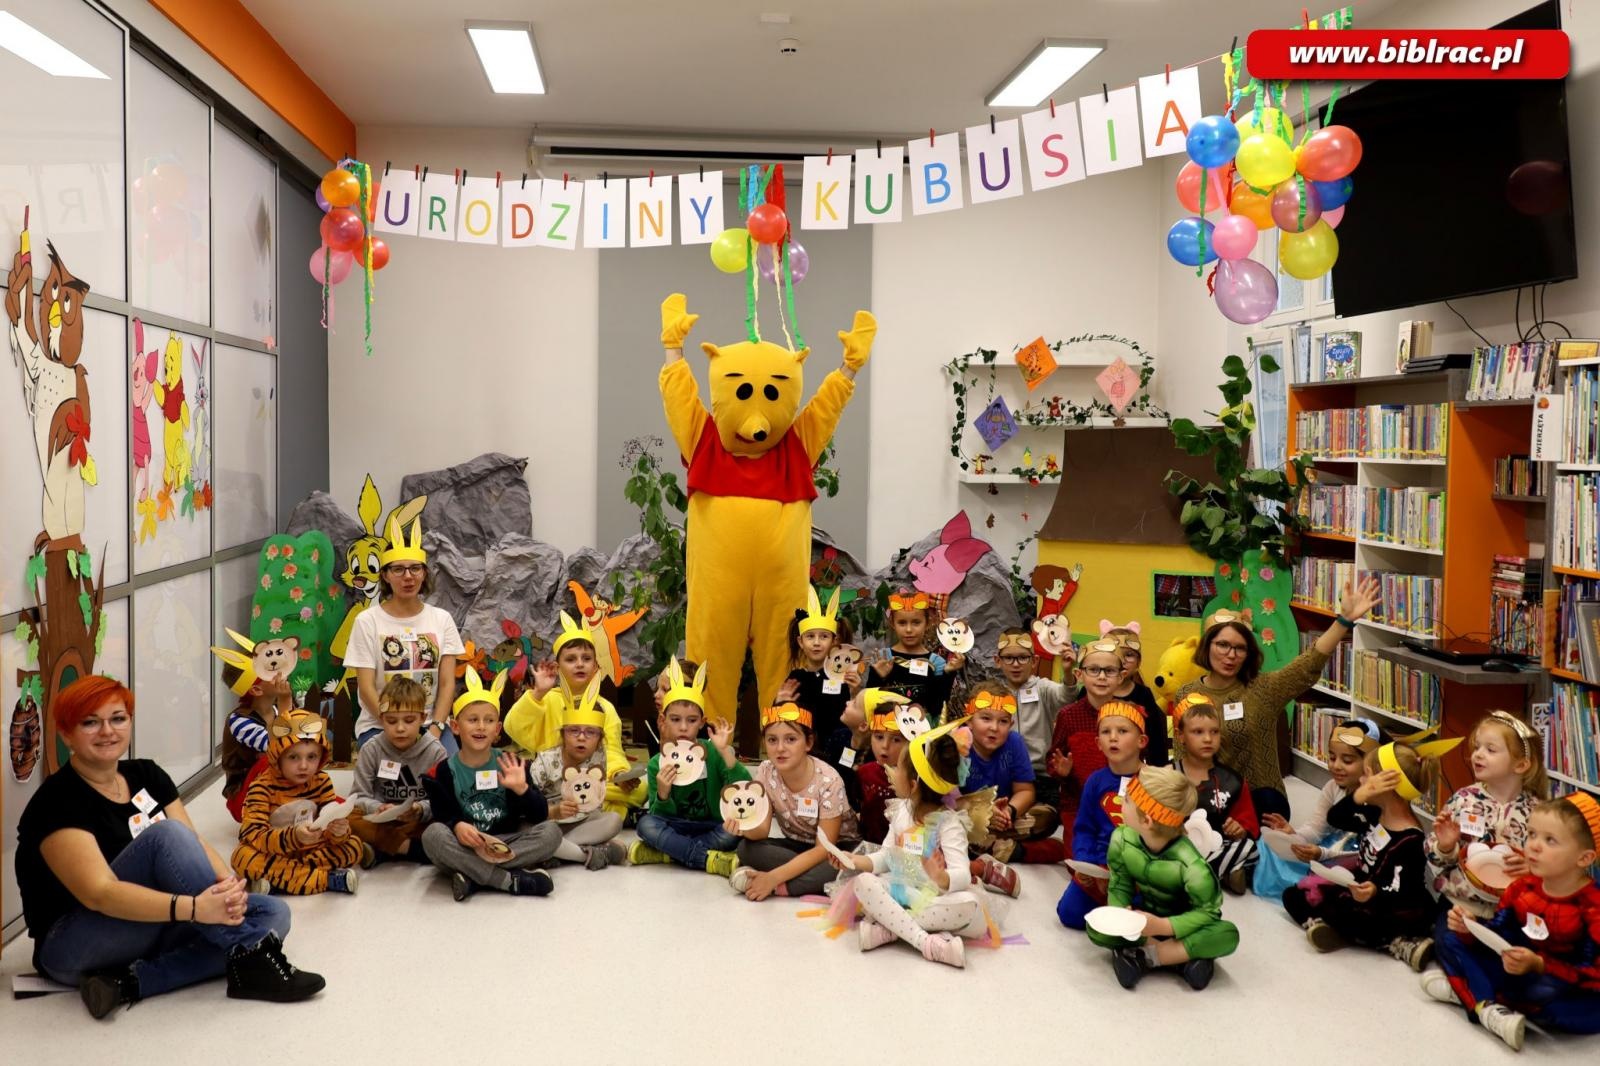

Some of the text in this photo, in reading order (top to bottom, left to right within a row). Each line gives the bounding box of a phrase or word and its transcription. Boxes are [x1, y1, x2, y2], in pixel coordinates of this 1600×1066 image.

[383, 99, 1190, 242] URODZINY KUBUSIA
[1535, 413, 1545, 459] ZWIERZĘTA
[383, 786, 426, 800] didas
